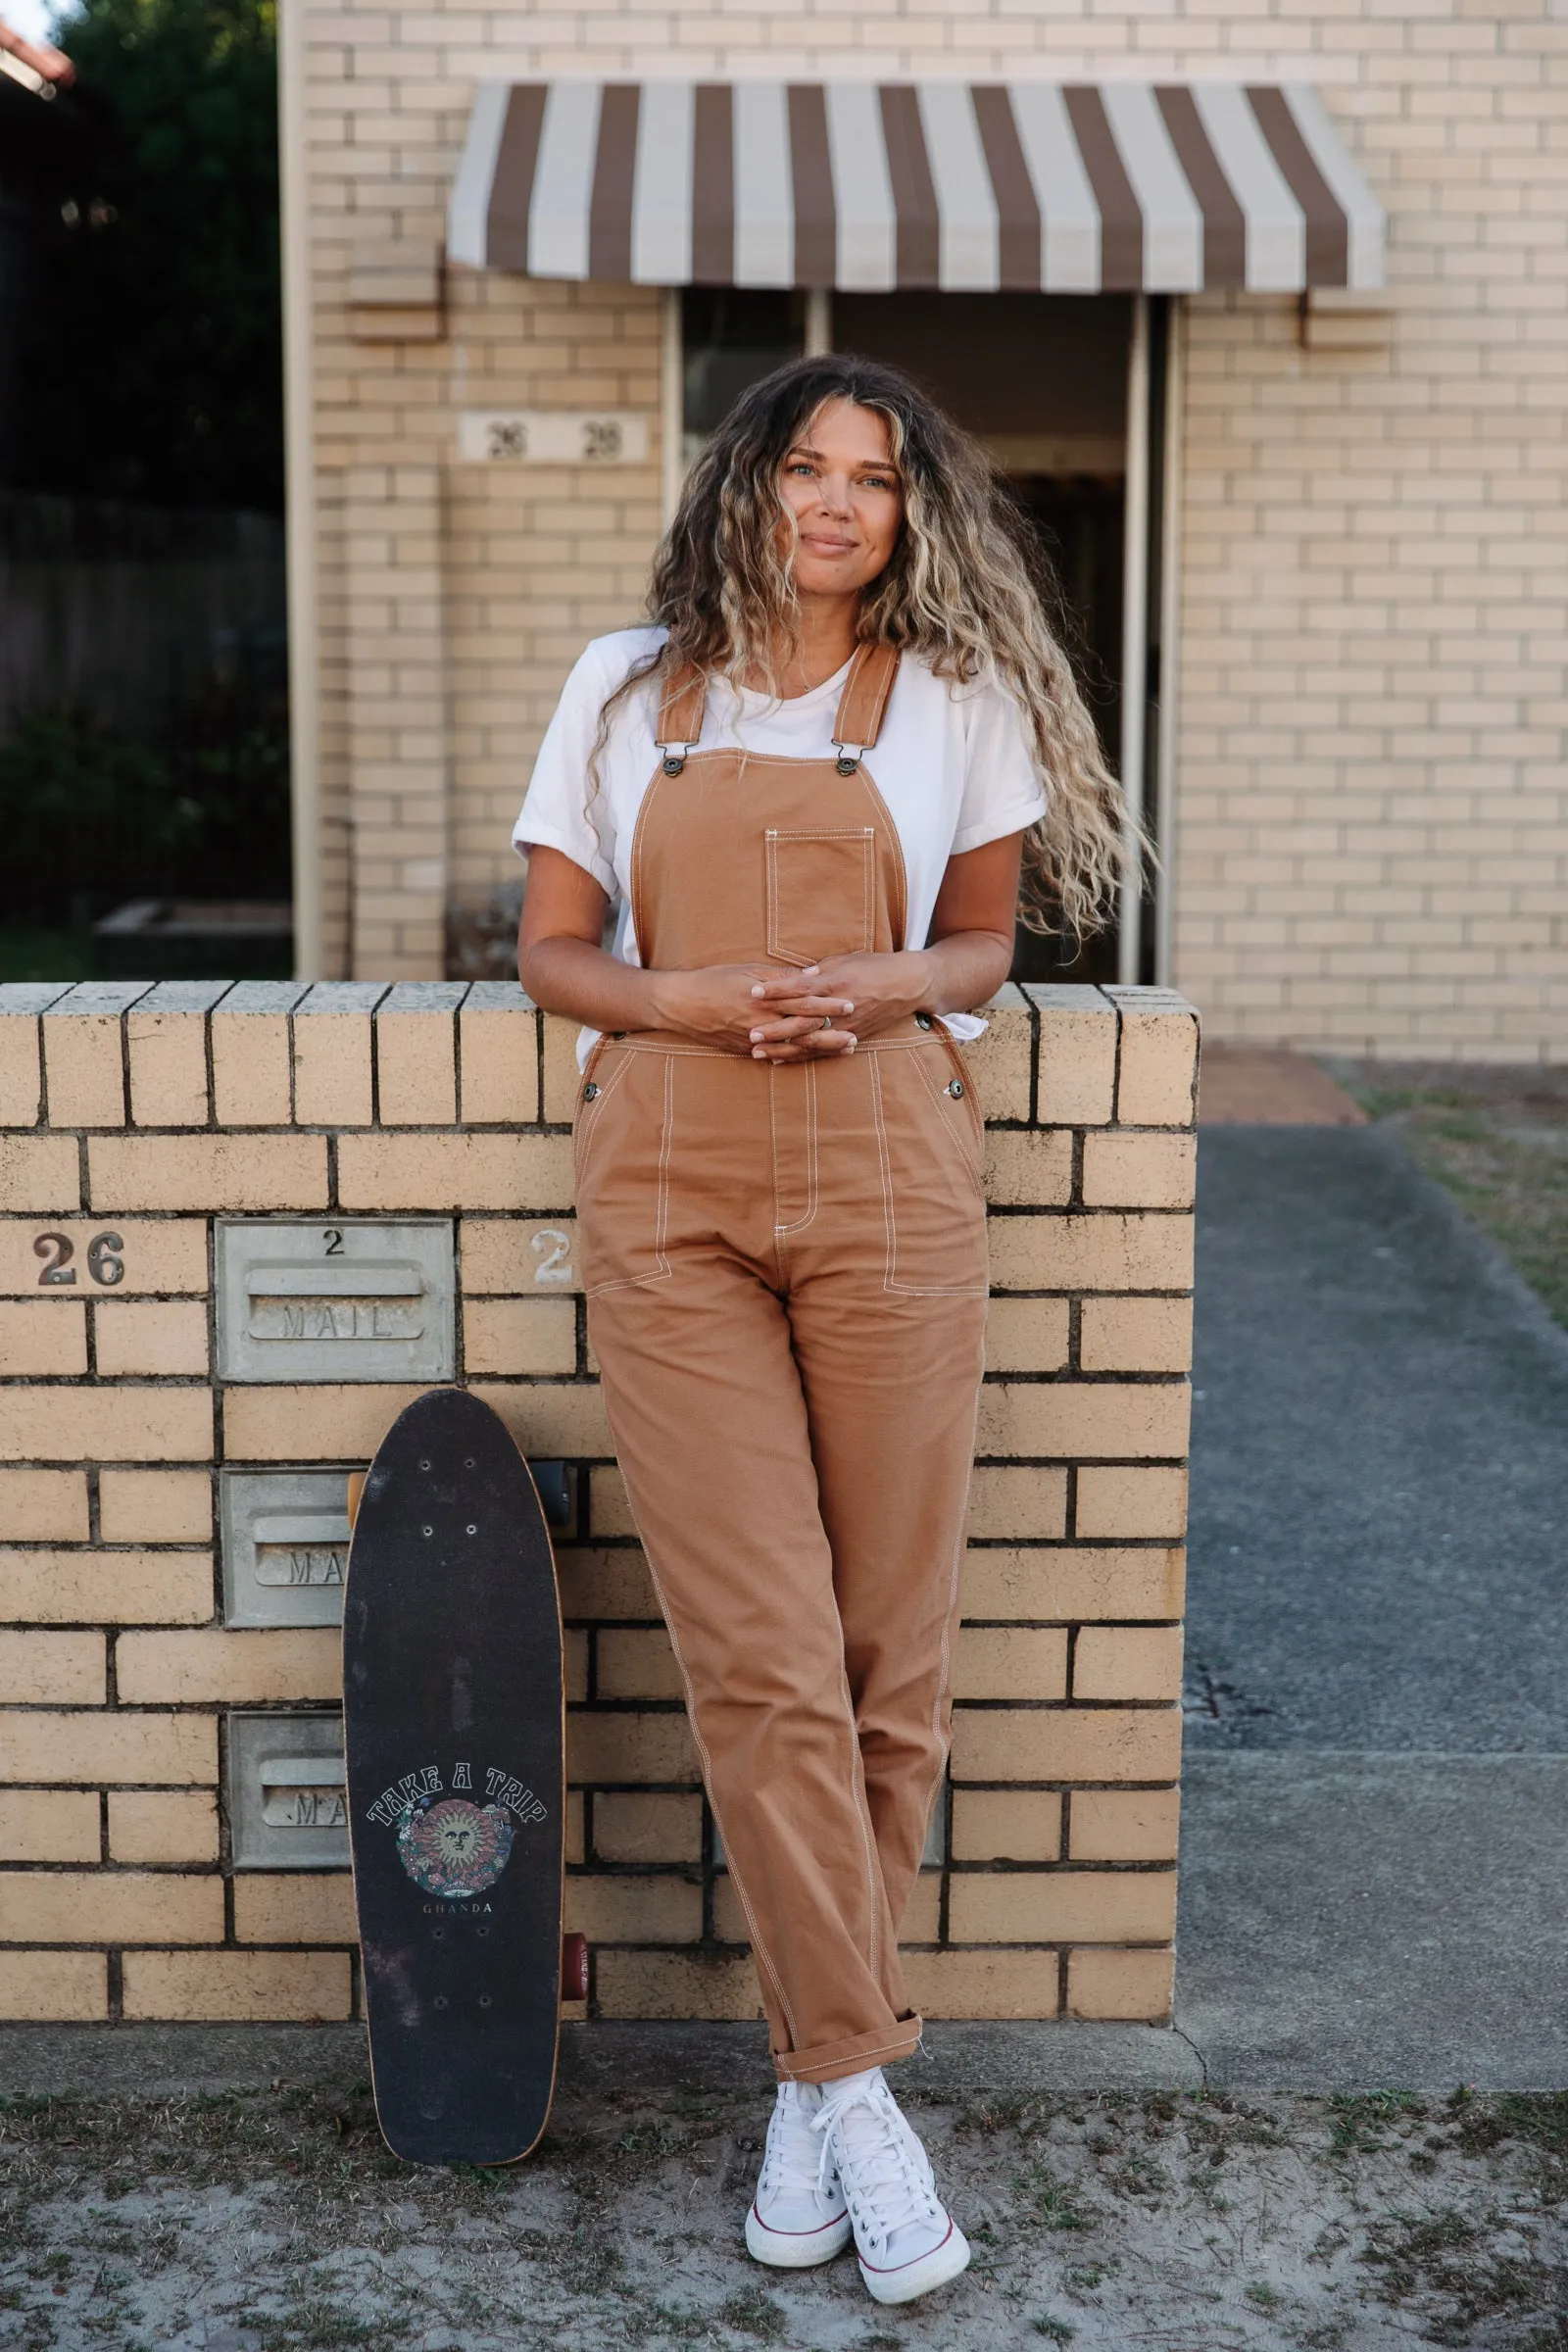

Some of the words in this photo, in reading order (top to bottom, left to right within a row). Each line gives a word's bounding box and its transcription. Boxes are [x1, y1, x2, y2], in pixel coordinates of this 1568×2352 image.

[33, 1231, 124, 1286] 26
[323, 1229, 345, 1256] 2
[530, 1228, 573, 1285] 2
[281, 1305, 393, 1338] MAIL
[288, 1550, 345, 1584] MA
[296, 1792, 348, 1826] MA
[366, 1765, 444, 1828] TAKE
[452, 1762, 473, 1789] A
[485, 1767, 549, 1823] TRIP
[422, 1903, 493, 1914] GHANDA
